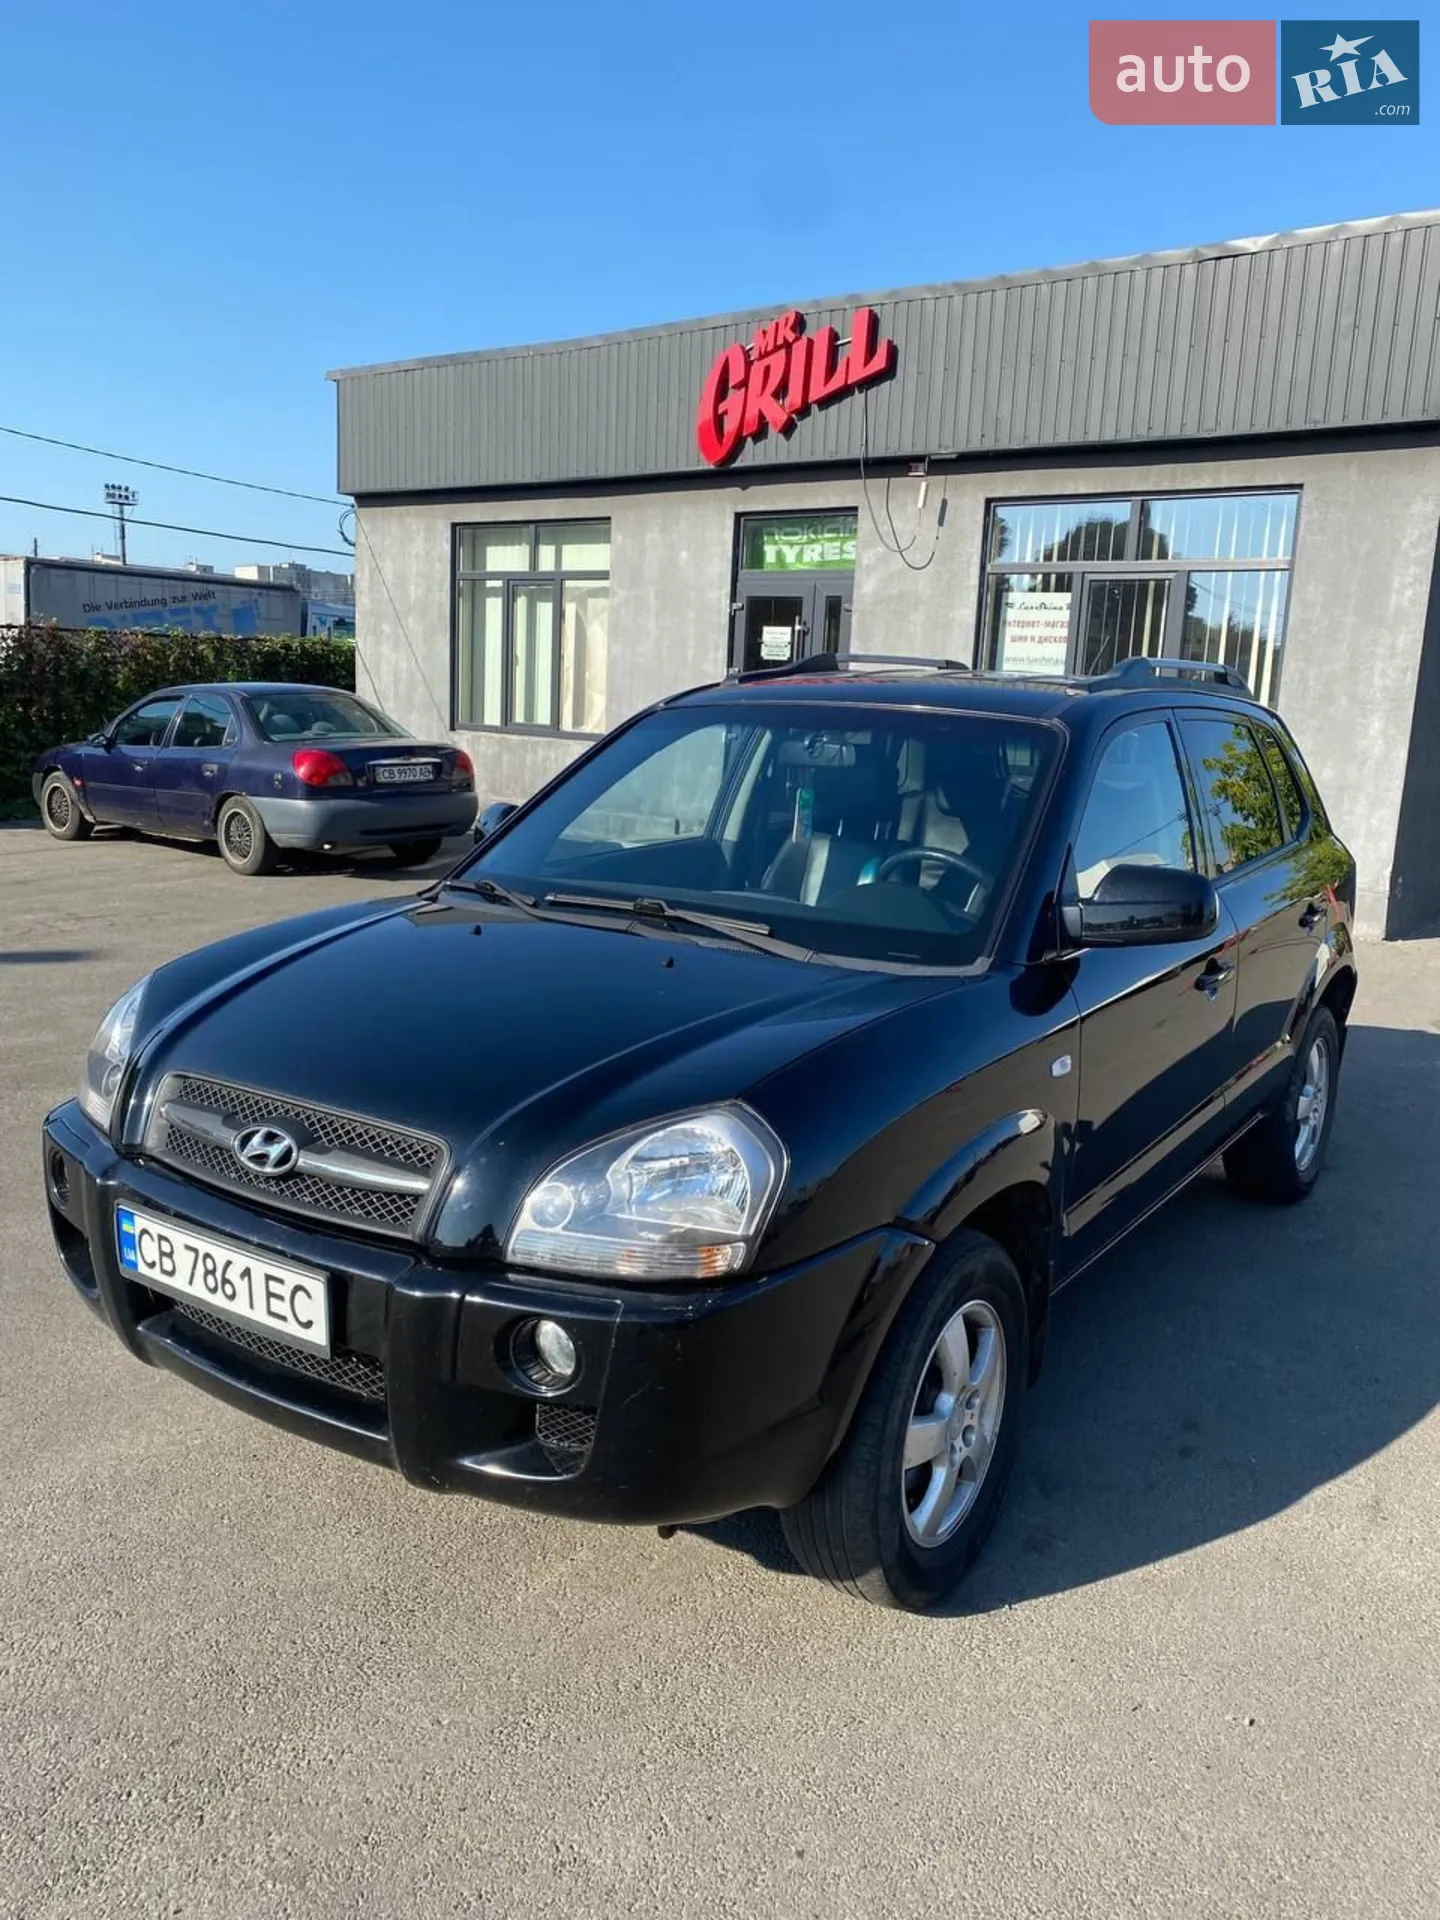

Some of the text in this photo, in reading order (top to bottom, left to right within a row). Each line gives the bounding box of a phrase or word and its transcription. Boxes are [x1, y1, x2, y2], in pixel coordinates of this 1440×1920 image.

[753, 311, 800, 358] MR
[697, 306, 895, 466] GRILL
[763, 540, 857, 564] TYRES
[83, 590, 217, 613] Die Verbindung zur Welt
[137, 1227, 314, 1330] CB 7861 EC
